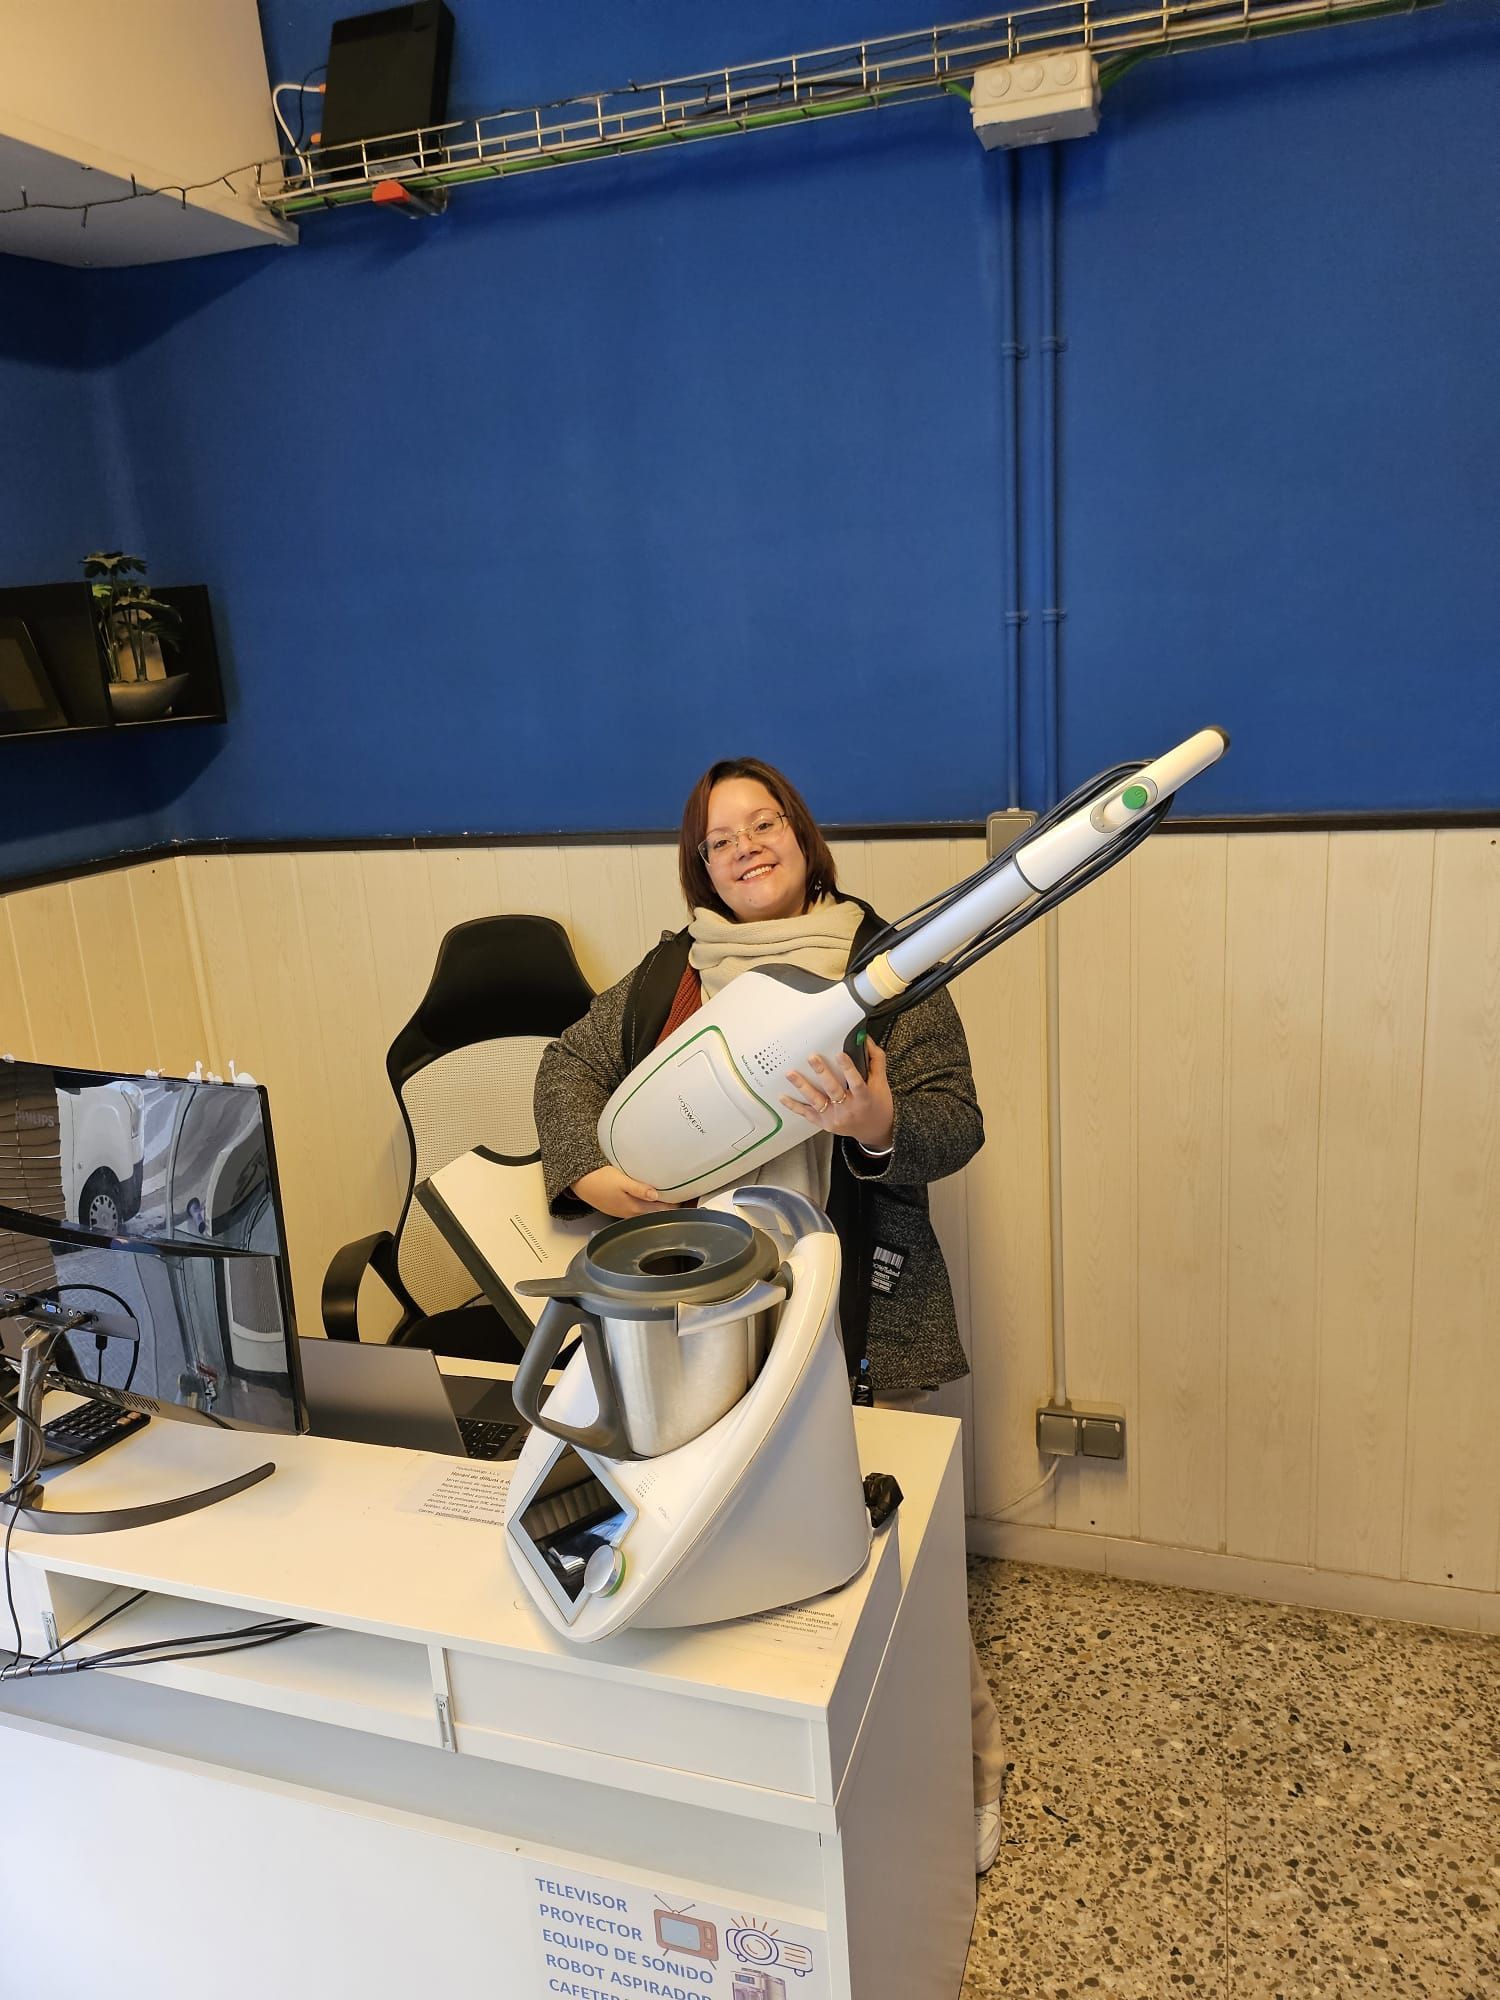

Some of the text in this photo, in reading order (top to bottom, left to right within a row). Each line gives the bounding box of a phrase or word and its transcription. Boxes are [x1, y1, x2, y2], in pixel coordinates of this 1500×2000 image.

[15, 1110, 55, 1128] PHILIPS
[535, 1878, 628, 1913] TELEVISOR
[539, 1903, 643, 1942] PROYECTOR
[542, 1929, 713, 1984] EQUIPO DE SONIDO
[545, 1953, 605, 1980] ROBOT
